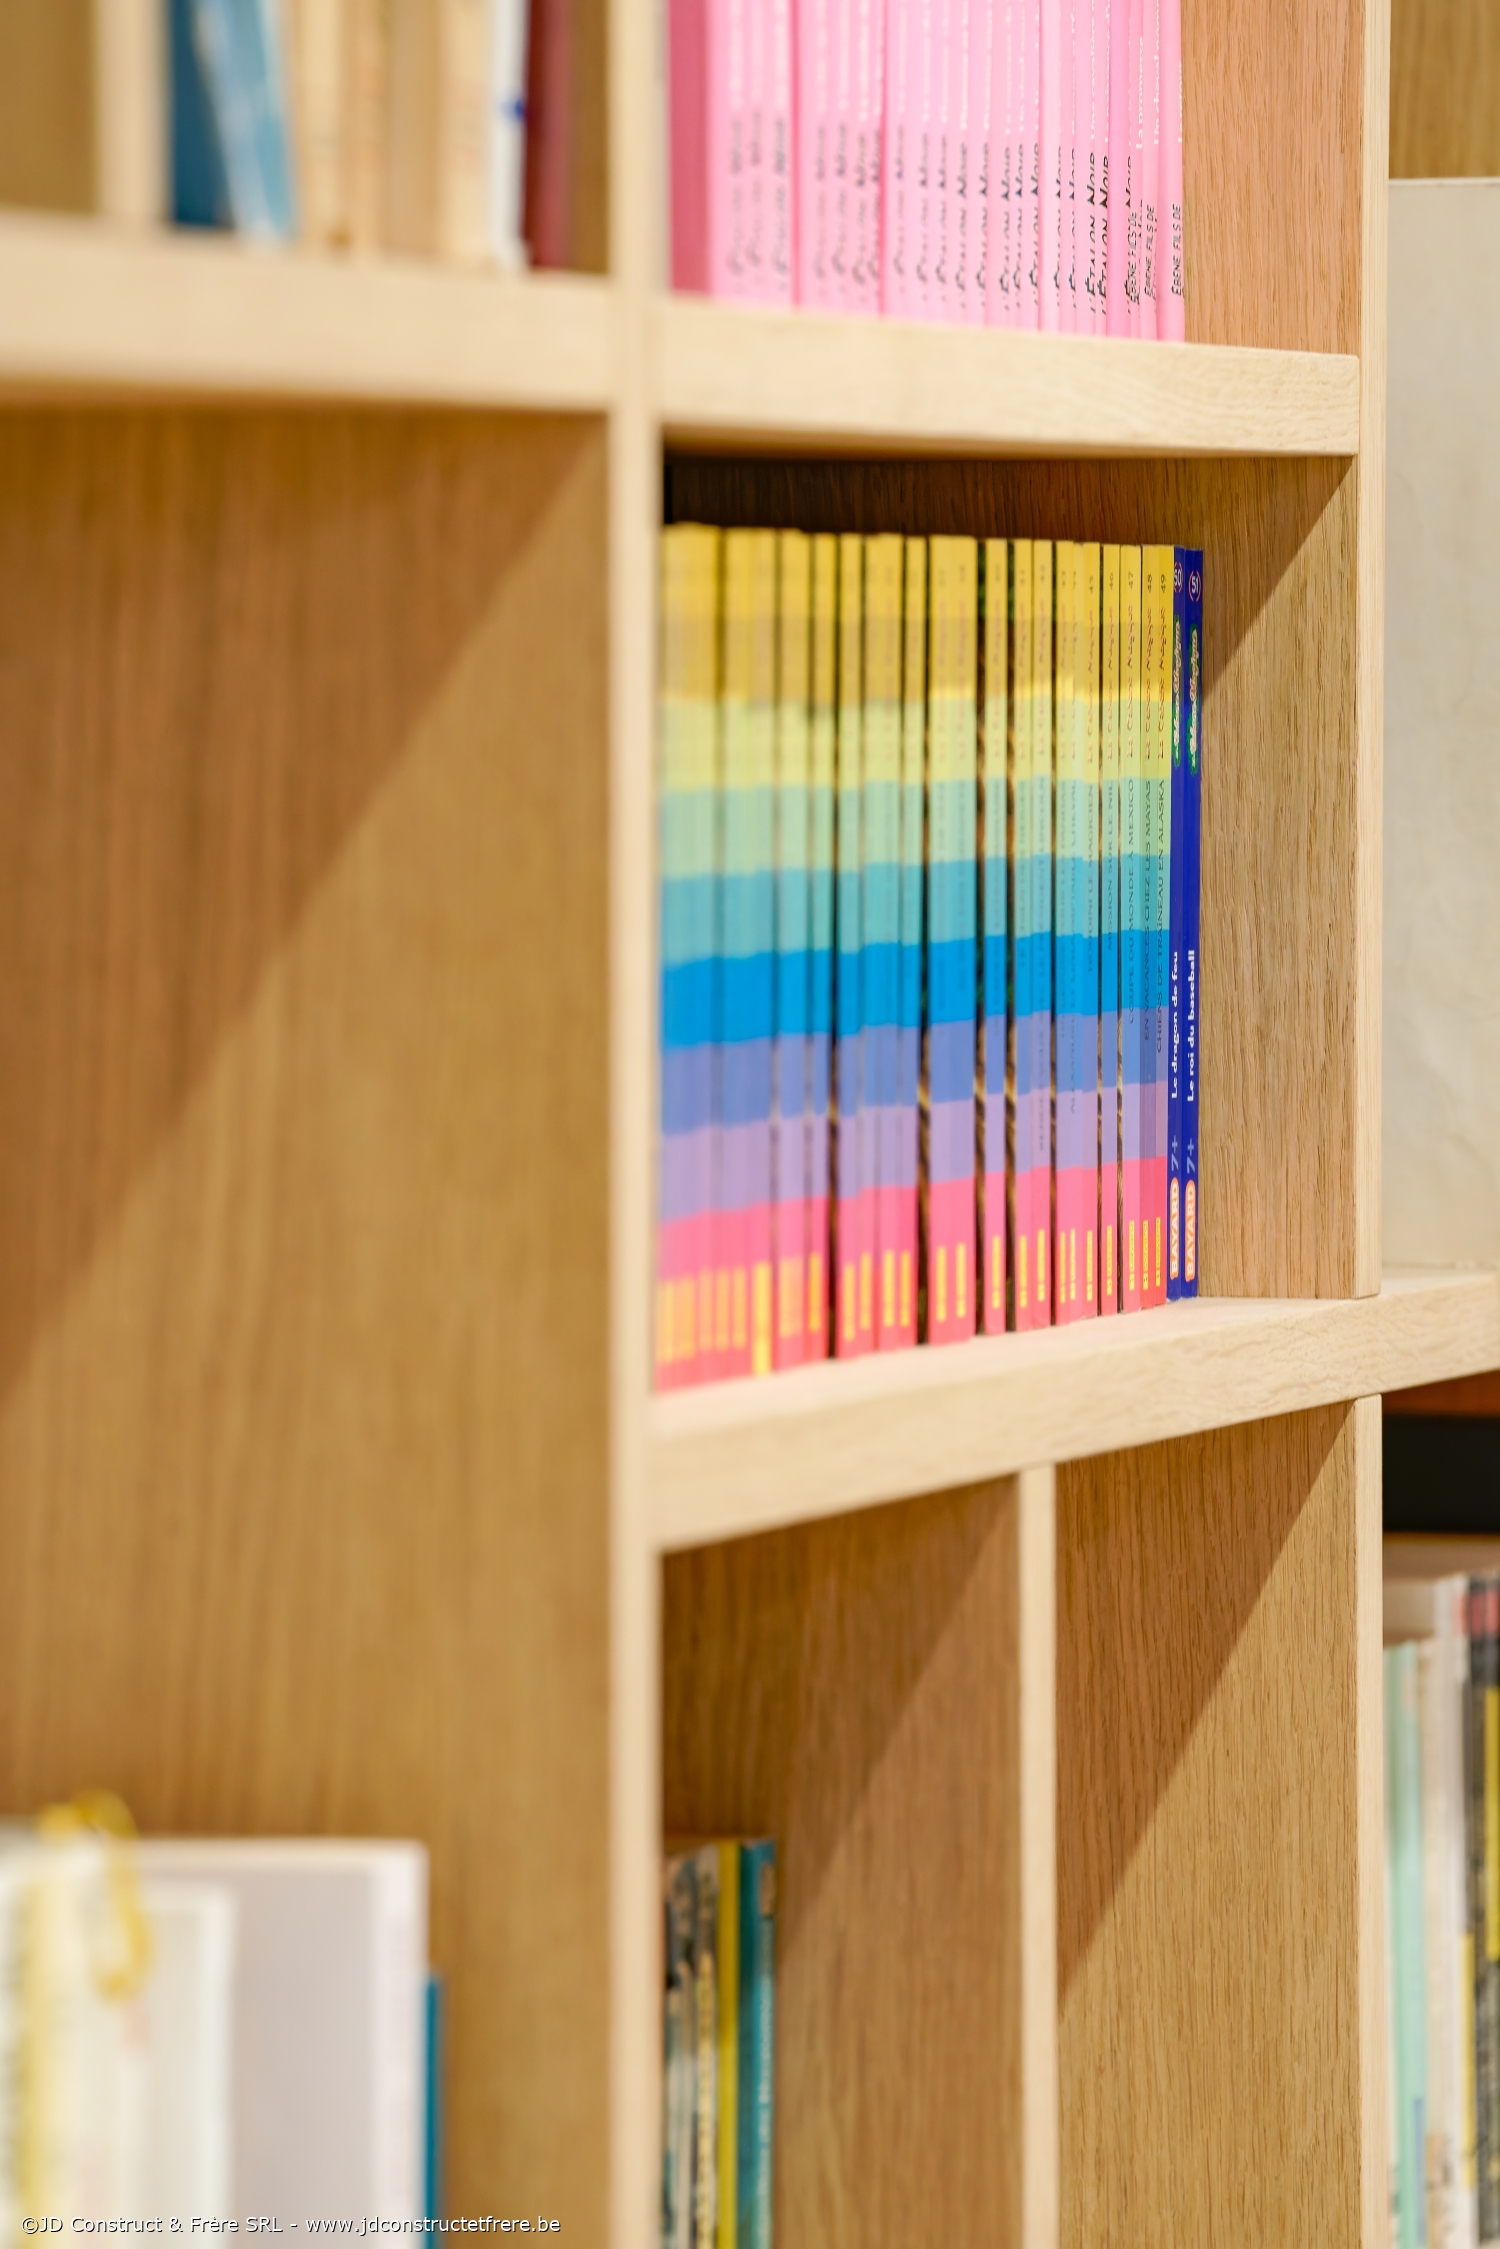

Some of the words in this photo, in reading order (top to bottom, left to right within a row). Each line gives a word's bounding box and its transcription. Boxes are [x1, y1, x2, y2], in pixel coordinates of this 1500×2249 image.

[1172, 203, 1181, 221] DE
[1172, 223, 1181, 252] FILS
[1128, 570, 1134, 590] 47
[1147, 573, 1153, 594] 48
[1160, 573, 1166, 594] 49
[1191, 576, 1199, 594] 51
[1158, 848, 1164, 871] EN
[1128, 937, 1134, 961] DU
[1157, 962, 1162, 988] DE
[1187, 949, 1195, 1020] baseball
[1171, 985, 1178, 1008] de
[1144, 1019, 1149, 1041] EN
[1187, 1025, 1195, 1049] du
[1171, 1012, 1180, 1074] dragon
[1171, 1077, 1178, 1099] Le
[1187, 1080, 1194, 1102] Le
[1171, 1135, 1178, 1172] 7+
[1187, 1138, 1195, 1175] 7+
[1187, 1185, 1195, 1276] BAYARD
